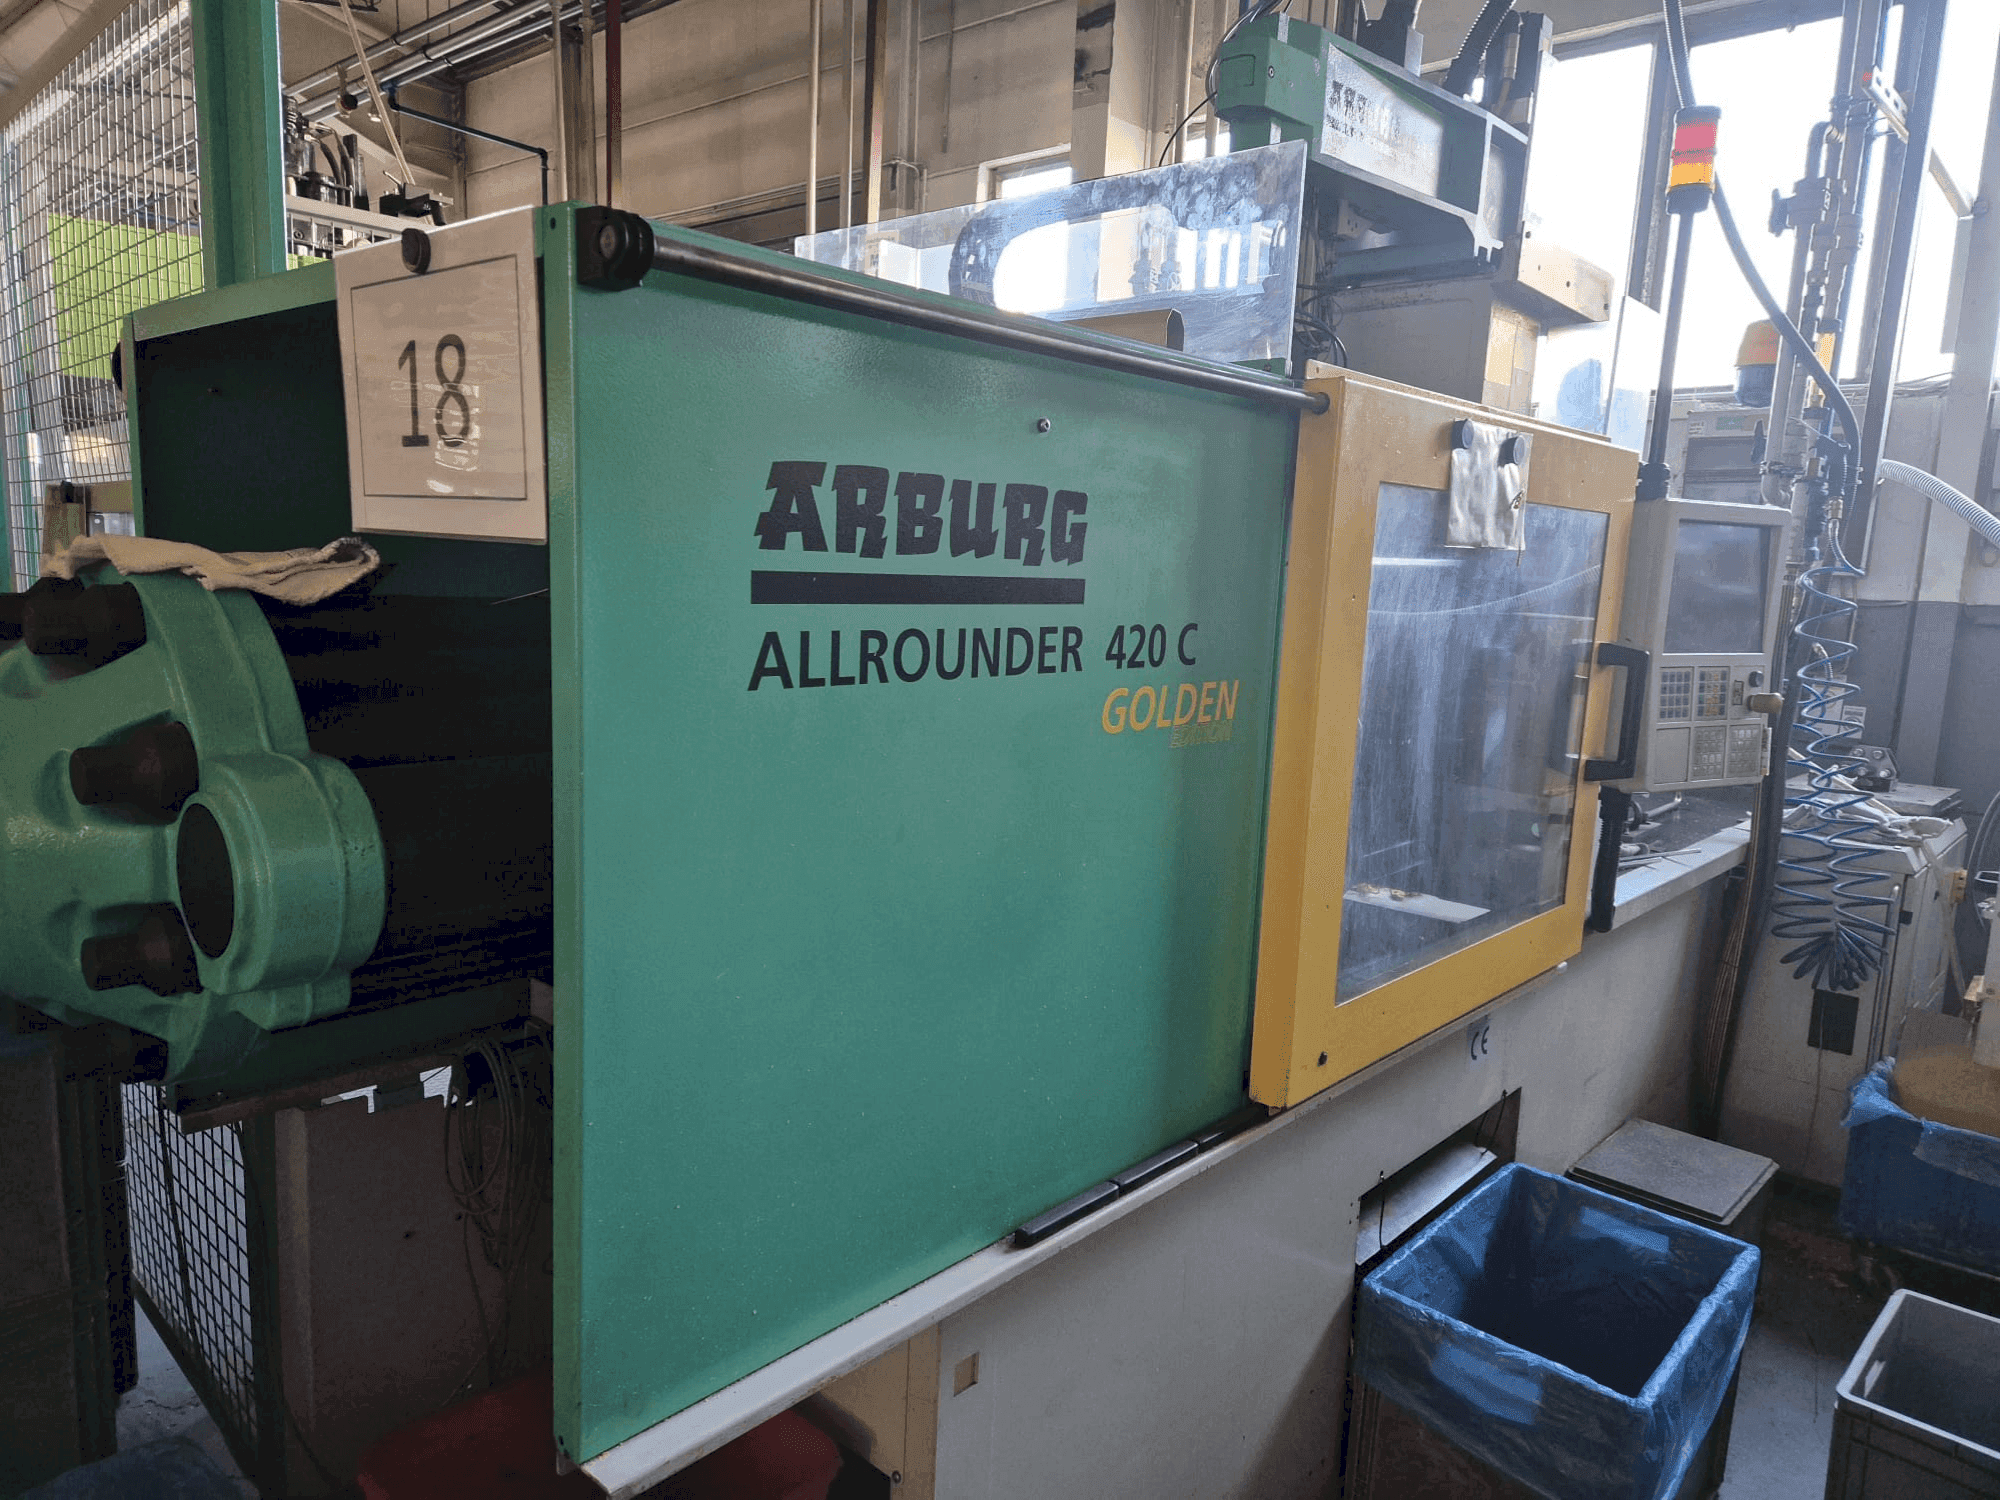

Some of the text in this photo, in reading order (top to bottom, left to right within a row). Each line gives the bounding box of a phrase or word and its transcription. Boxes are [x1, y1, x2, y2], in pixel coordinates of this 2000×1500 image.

[398, 333, 471, 448] 18
[753, 461, 1089, 567] ARBURG
[747, 622, 1199, 691] ALLROUNDER 420 C
[1101, 680, 1239, 734] GOLDEN
